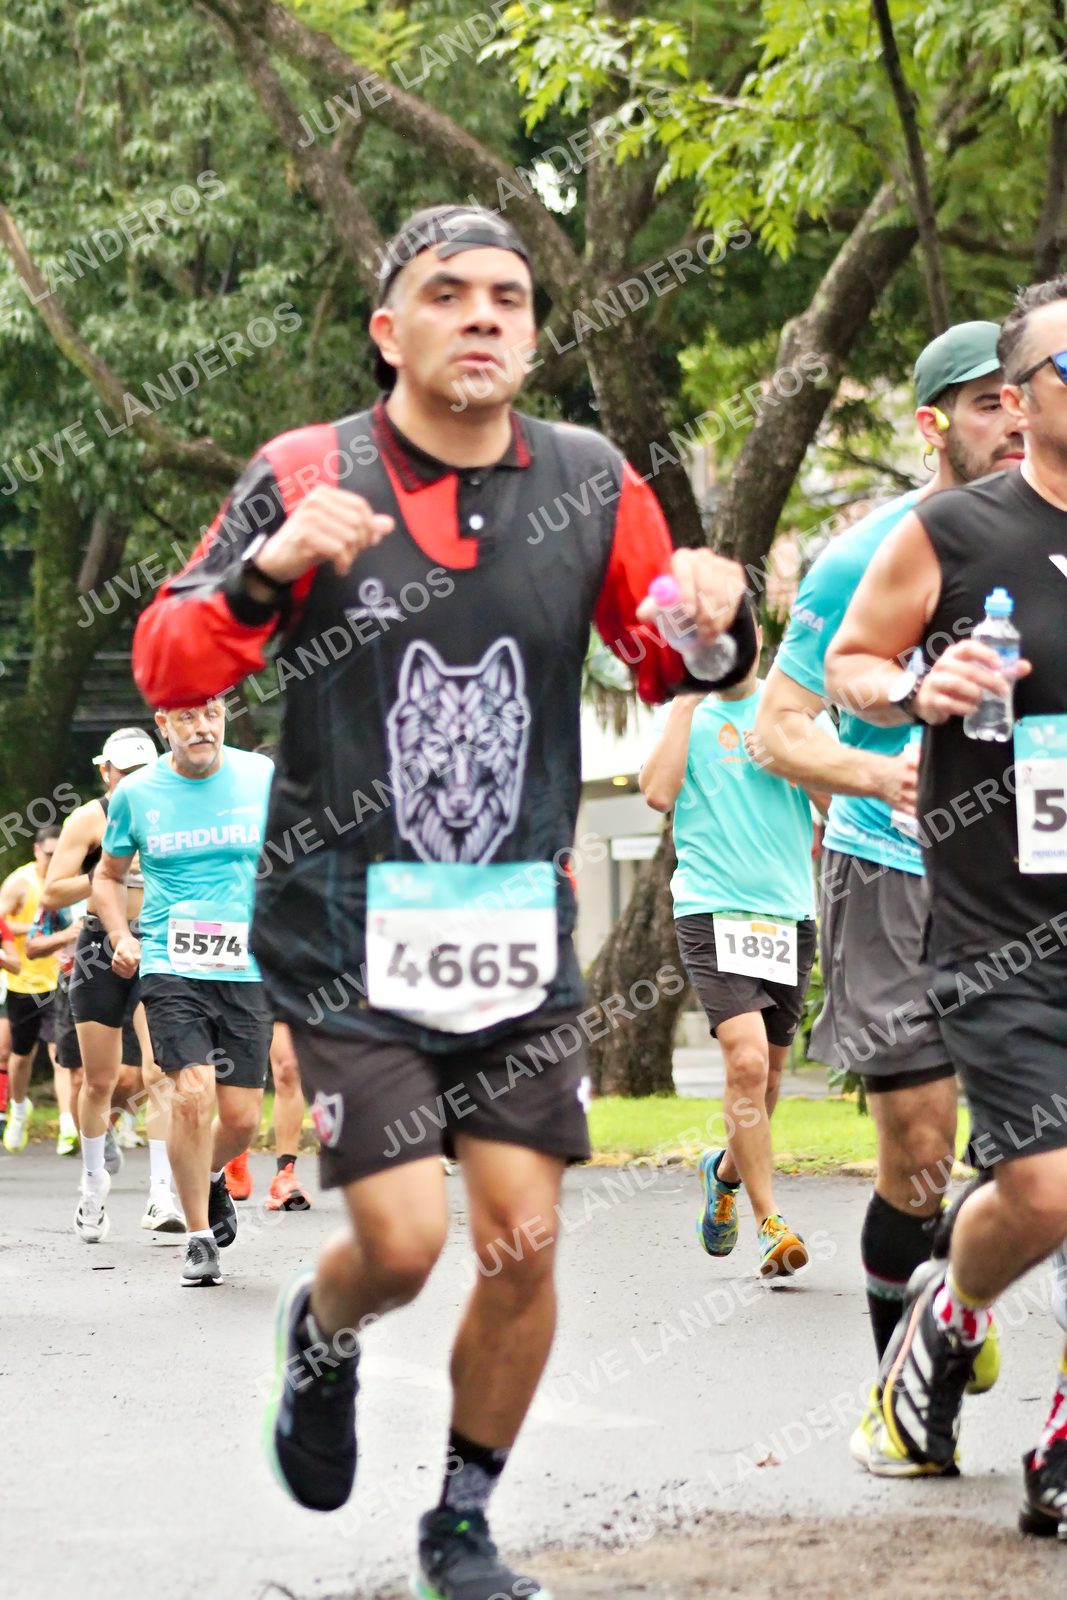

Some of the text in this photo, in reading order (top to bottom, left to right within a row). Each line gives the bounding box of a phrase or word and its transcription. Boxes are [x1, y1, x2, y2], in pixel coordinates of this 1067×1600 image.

[146, 823, 261, 854] PERDURA
[173, 932, 242, 956] 5574
[724, 933, 790, 964] 1892
[387, 942, 539, 988] 4665
